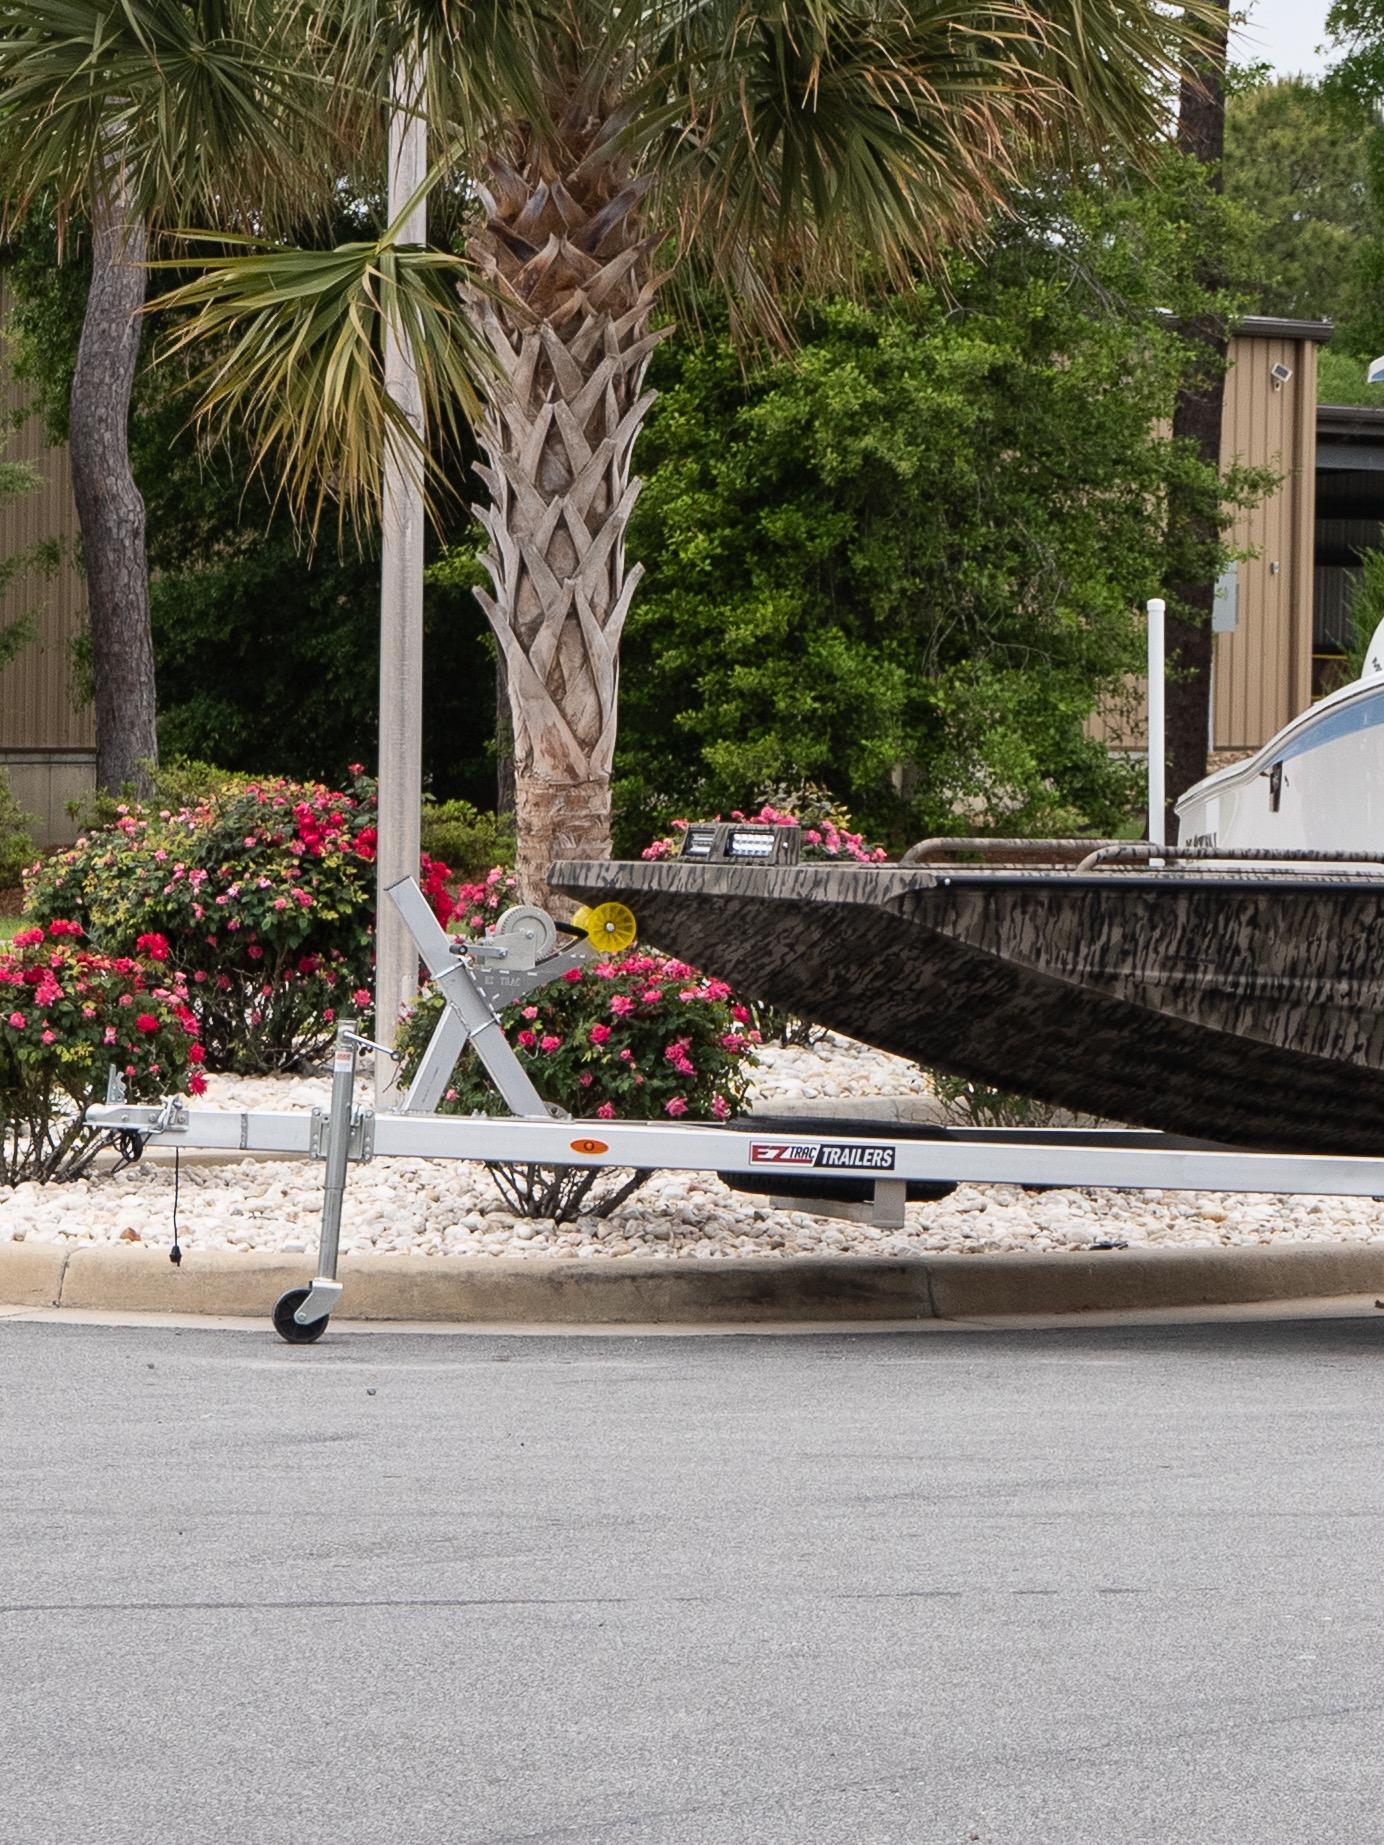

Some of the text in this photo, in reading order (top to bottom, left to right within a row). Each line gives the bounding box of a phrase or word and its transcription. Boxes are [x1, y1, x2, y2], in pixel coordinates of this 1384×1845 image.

[752, 1144, 893, 1167] EZ TRAC TRAILERS
